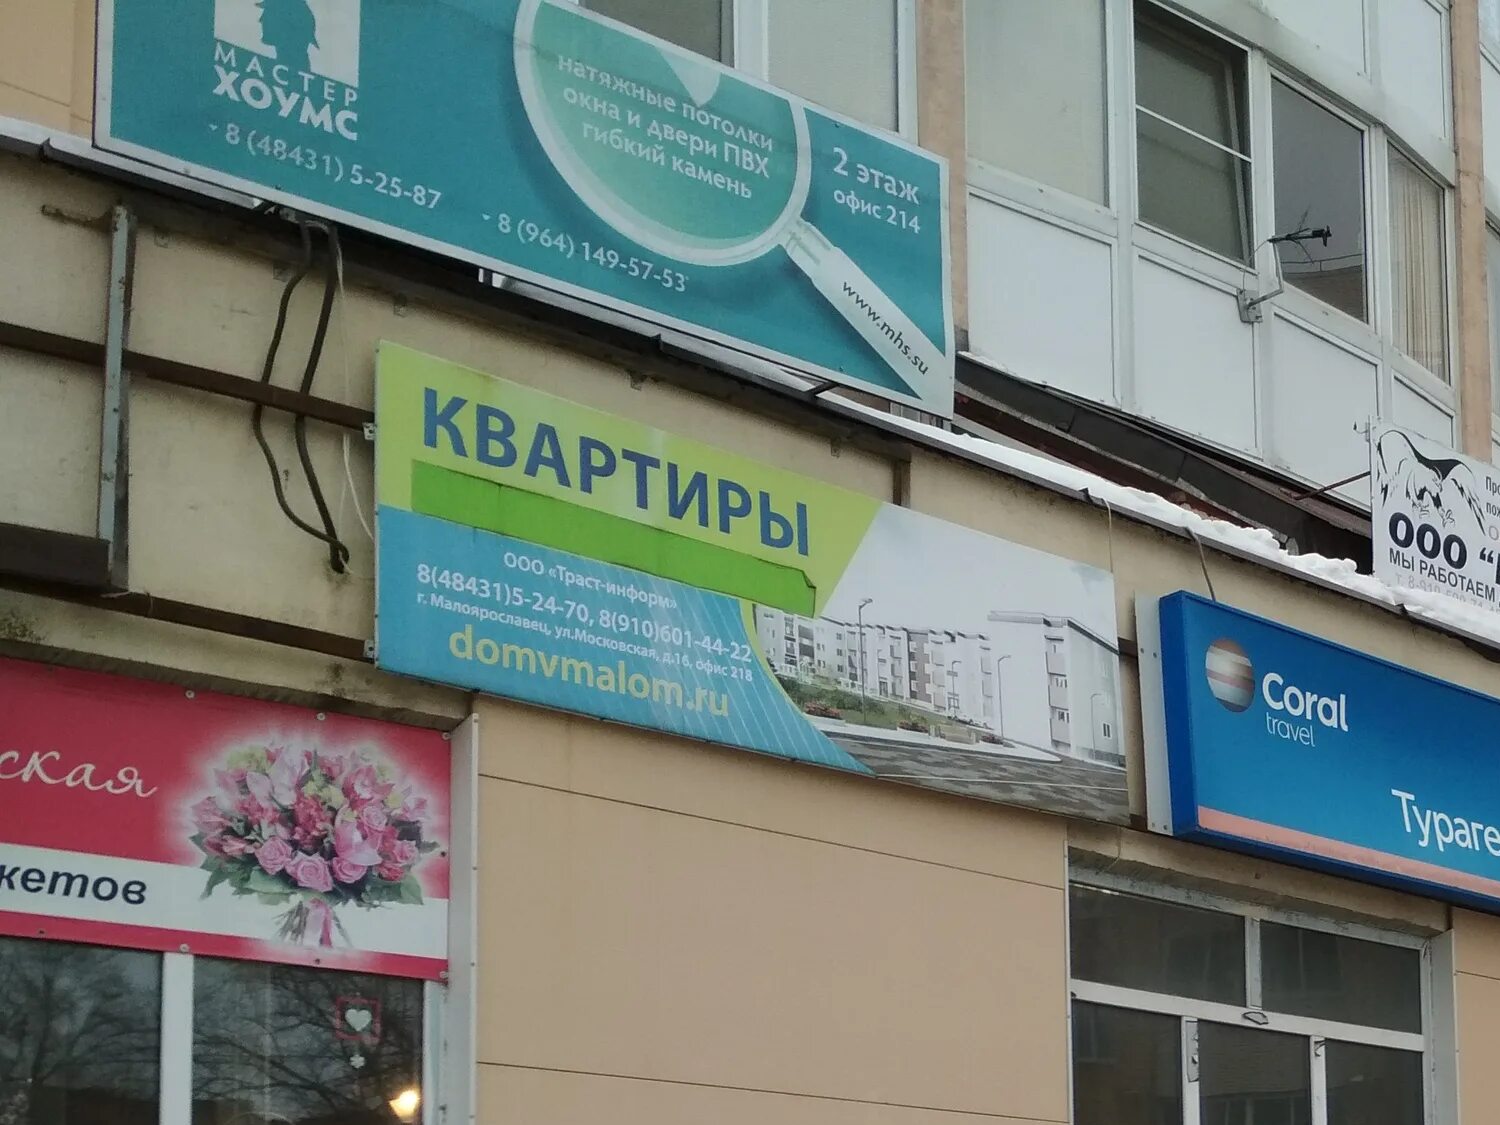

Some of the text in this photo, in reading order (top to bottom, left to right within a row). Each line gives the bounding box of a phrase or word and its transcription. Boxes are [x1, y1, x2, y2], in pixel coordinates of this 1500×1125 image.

[213, 64, 358, 141] ХОУМС
[214, 42, 358, 106] МАСТЕР
[558, 55, 773, 152] натяжные потолки
[225, 123, 442, 209] 8 (48431) 5-25-87
[563, 87, 770, 178] окна и двери ПВХ
[582, 122, 752, 200] гибкий камень
[833, 147, 920, 205] 2 этаж
[833, 189, 920, 235] офис 214
[497, 213, 687, 293] 8 (964) 149-57-53
[842, 281, 929, 376] www.mhs.su
[423, 387, 810, 557] КВАРТИРЫ
[1388, 511, 1467, 570] ООО
[1389, 547, 1415, 572] МЫ
[1419, 559, 1495, 603] РАБОТАЕМ
[416, 563, 752, 664] 8(48431)5-24-70, 8(910)601-44-22
[503, 551, 677, 610] ООО «Траст-информ»
[417, 592, 427, 605] г.
[431, 594, 552, 636] Малоярославец,
[696, 659, 728, 679] офис
[731, 666, 753, 682] 218
[449, 624, 729, 717] domvmalom.ru
[1262, 672, 1348, 732] Coral
[1266, 712, 1315, 747] travel
[0, 865, 147, 905] кетов
